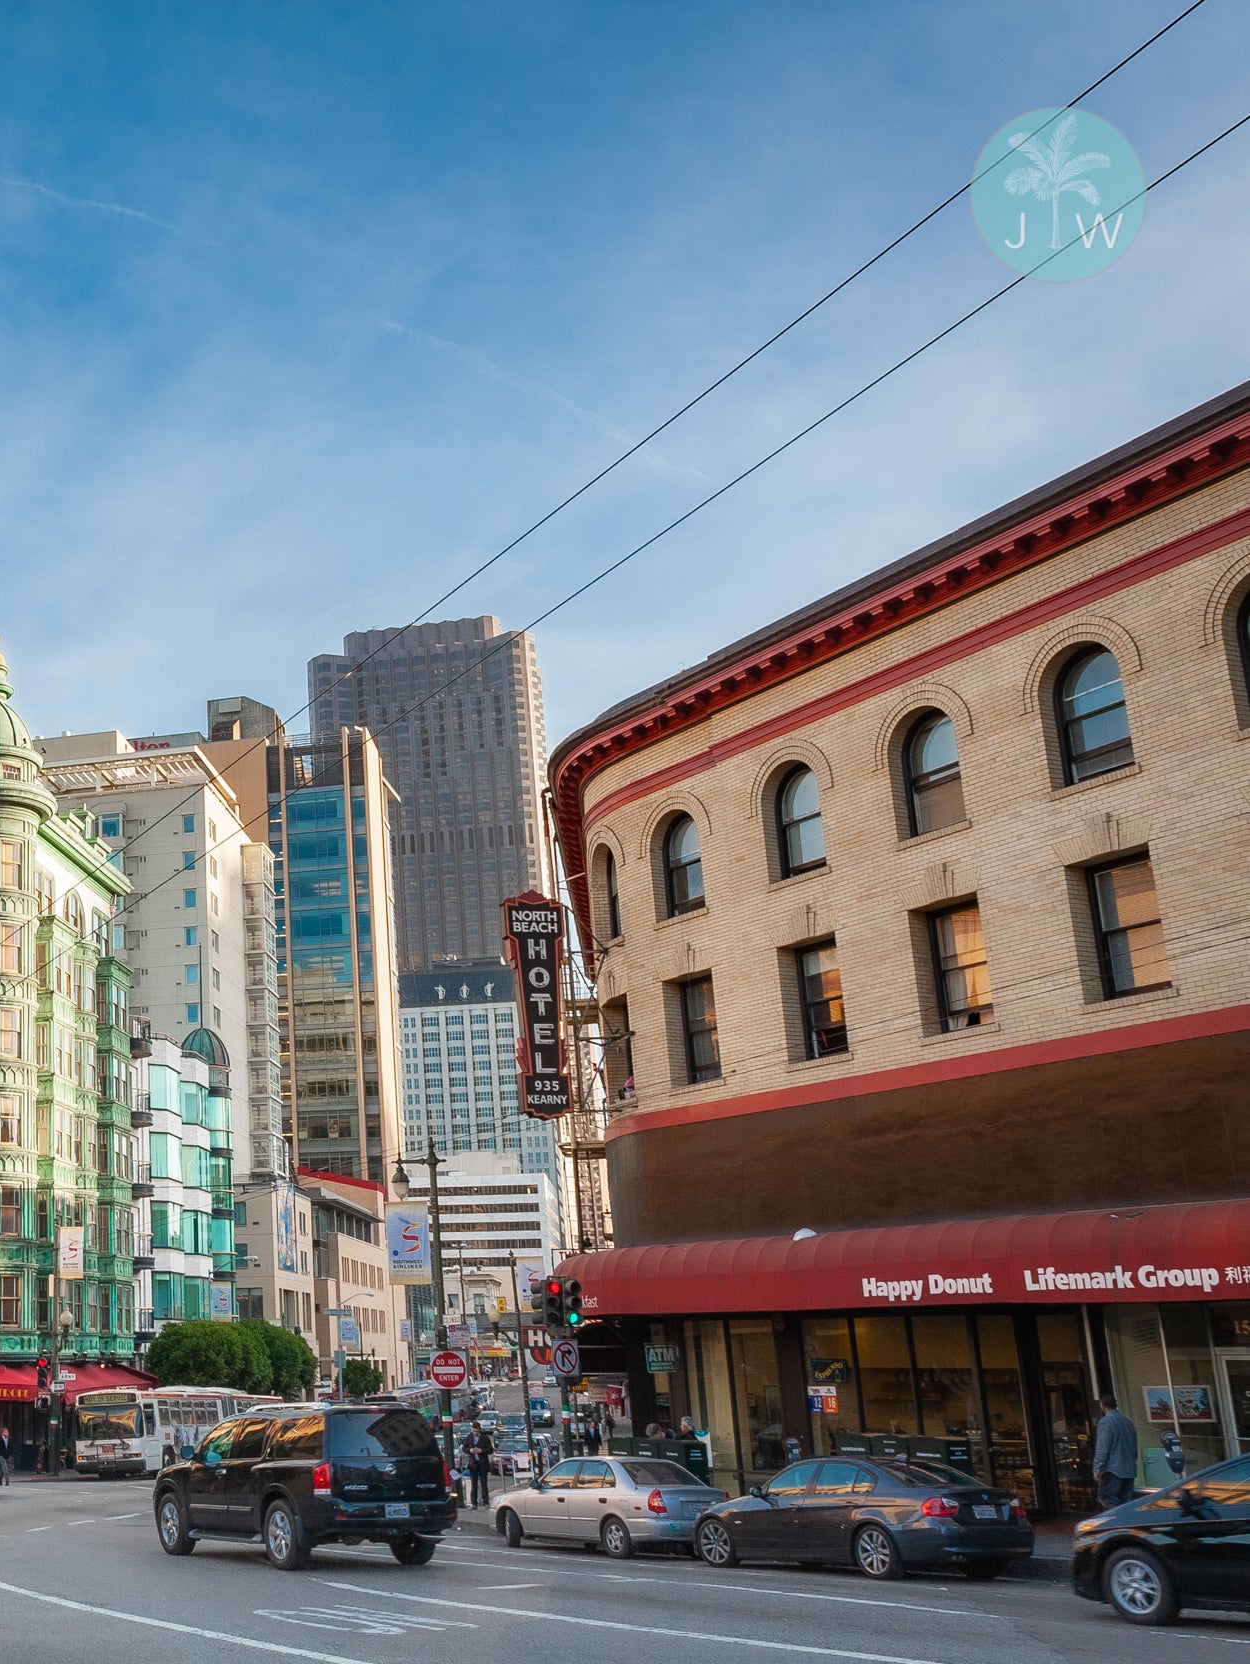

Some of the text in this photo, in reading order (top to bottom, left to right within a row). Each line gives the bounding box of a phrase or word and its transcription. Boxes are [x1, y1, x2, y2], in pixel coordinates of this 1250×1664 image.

[132, 741, 170, 752] lton
[511, 910, 557, 922] NORTH
[512, 921, 558, 933] BEACH
[527, 938, 558, 1074] HOTEL
[534, 1080, 560, 1091] 935
[527, 1094, 568, 1105] KEARNY
[1023, 1264, 1220, 1293] Lifemark Group
[861, 1272, 994, 1302] Happy Donut
[649, 1348, 674, 1361] ATM
[435, 1358, 461, 1366] DO NOT
[438, 1374, 460, 1382] ENTER
